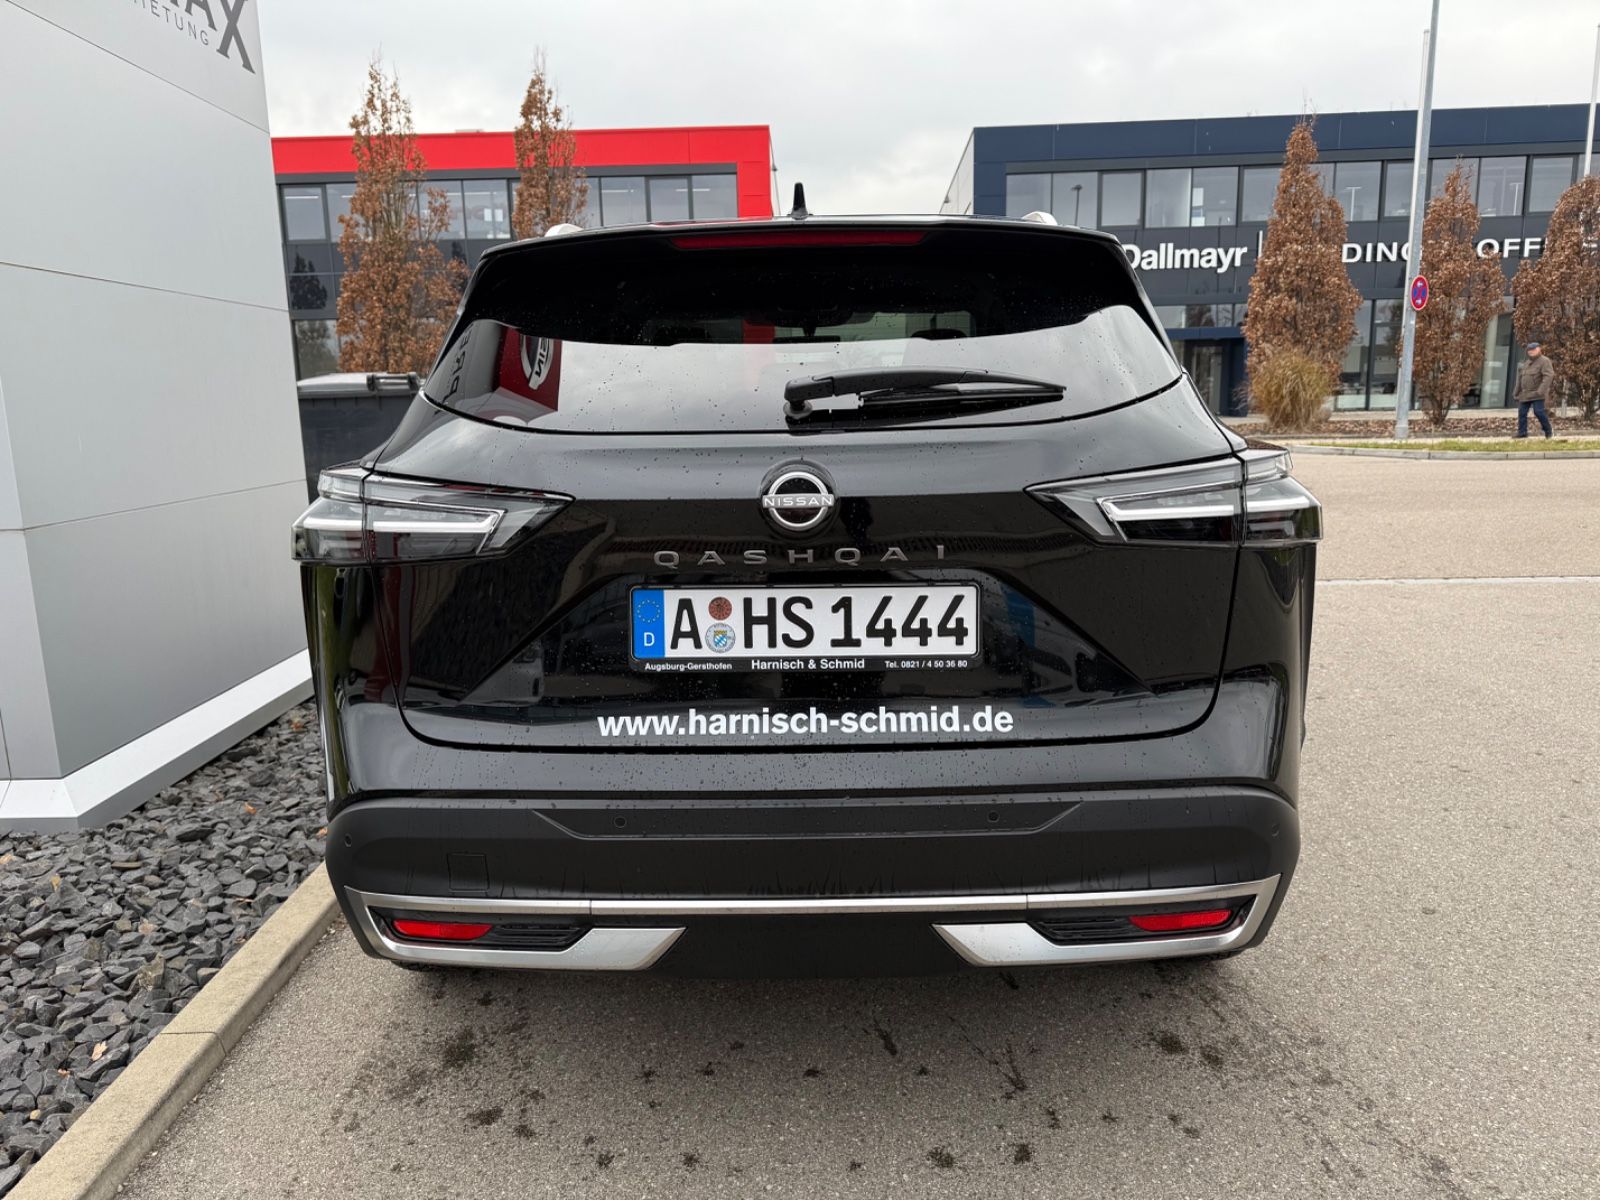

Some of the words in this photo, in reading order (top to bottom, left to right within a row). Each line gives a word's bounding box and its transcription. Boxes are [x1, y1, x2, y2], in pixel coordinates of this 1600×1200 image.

[1122, 243, 1247, 273] Dallmayr
[764, 496, 832, 506] NISSAN
[653, 545, 945, 568] QASHQAI
[670, 598, 703, 650] A
[743, 596, 815, 649] HS
[830, 594, 969, 648] 1444
[643, 632, 655, 647] D
[644, 662, 733, 672] Augsburg-Gersthofen
[751, 659, 804, 670] Harnisch
[807, 660, 817, 669] &
[819, 659, 865, 669] Schmid
[884, 660, 899, 668] Tel.
[900, 660, 920, 669] 0821
[926, 660, 933, 668] 4
[933, 660, 945, 668] 50
[597, 706, 1014, 737] www.harnisch-schmid.de
